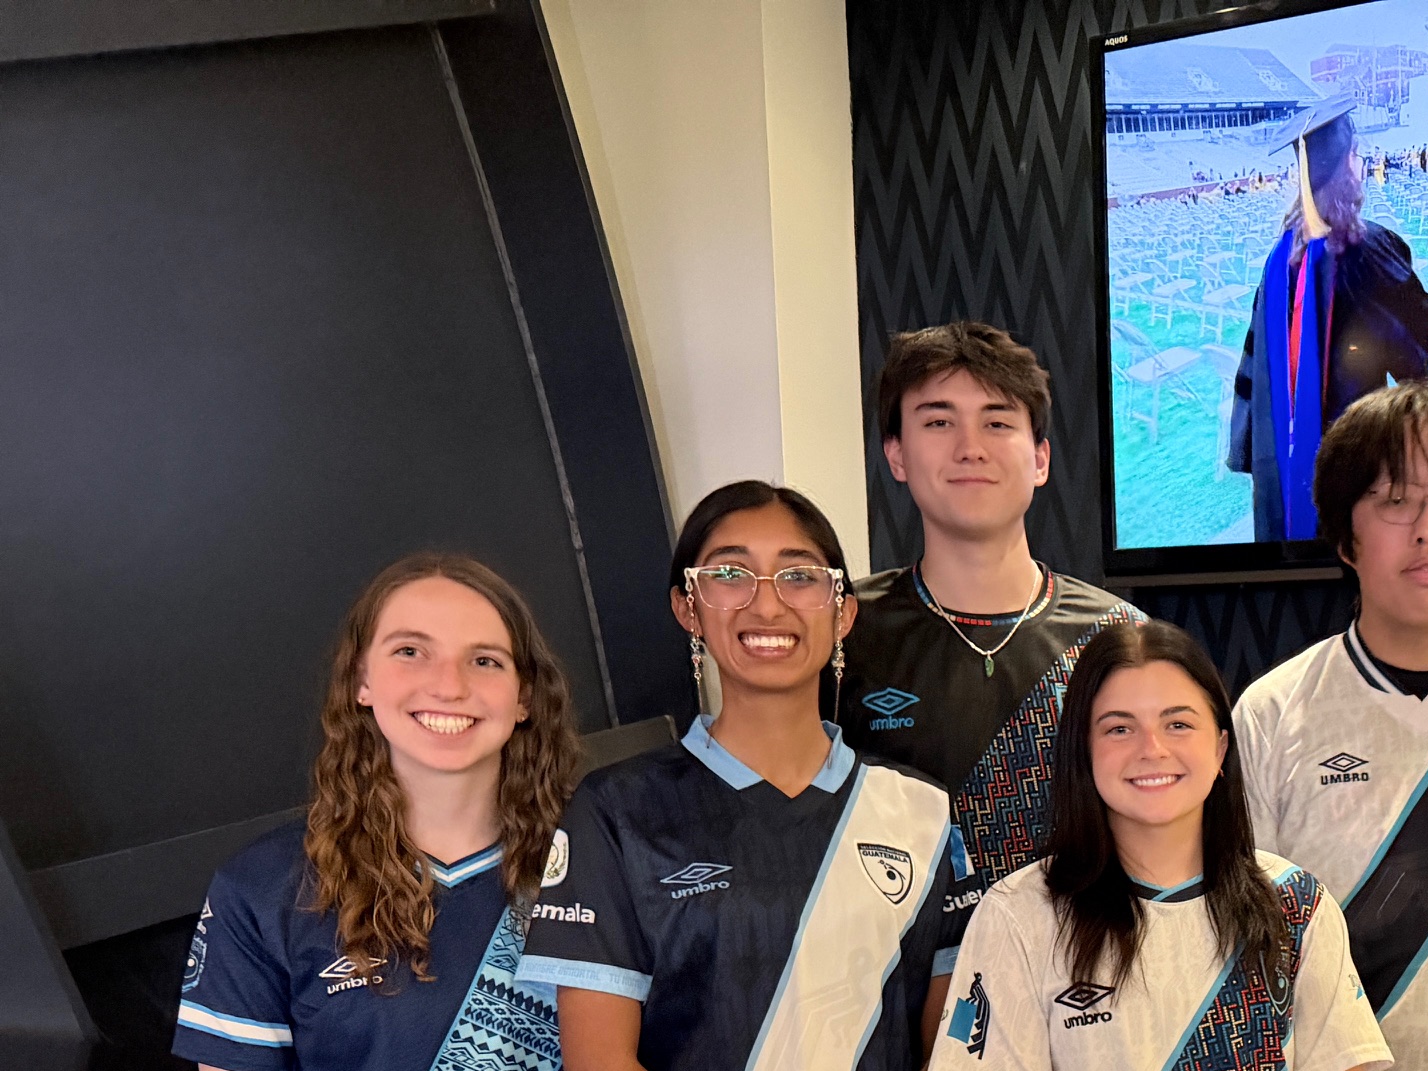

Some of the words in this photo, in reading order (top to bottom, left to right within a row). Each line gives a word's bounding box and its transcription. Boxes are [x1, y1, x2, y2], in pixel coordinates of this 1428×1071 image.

[1105, 35, 1128, 46] AQUOS
[869, 717, 915, 731] umbro
[1320, 772, 1369, 785] UMBRO
[862, 850, 909, 863] GUATEMALA
[671, 881, 730, 899] umbro
[1064, 1011, 1112, 1029] umbro
